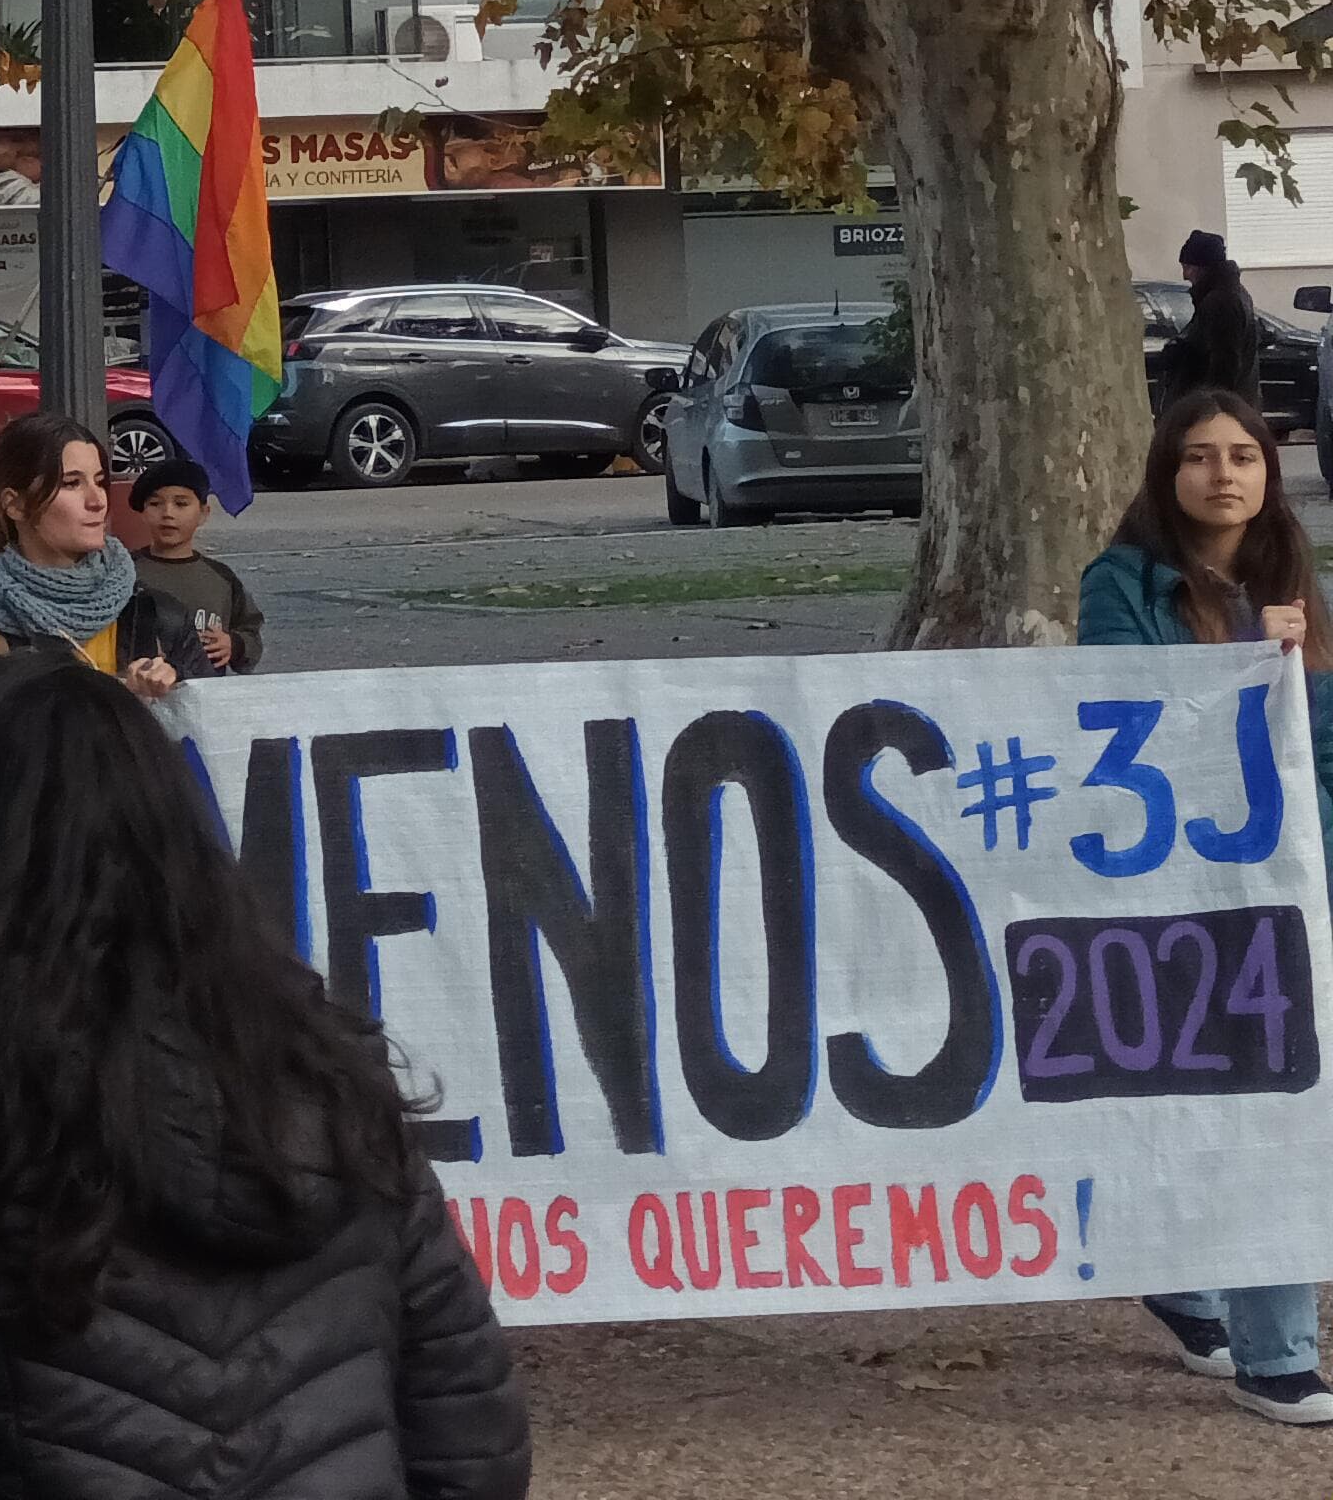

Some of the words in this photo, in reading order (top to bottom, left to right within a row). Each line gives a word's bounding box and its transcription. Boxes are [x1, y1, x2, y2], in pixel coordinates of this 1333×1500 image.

[290, 132, 415, 165] MASAS
[304, 166, 403, 186] CONFITERÍA
[1018, 917, 1289, 1077] 2024
